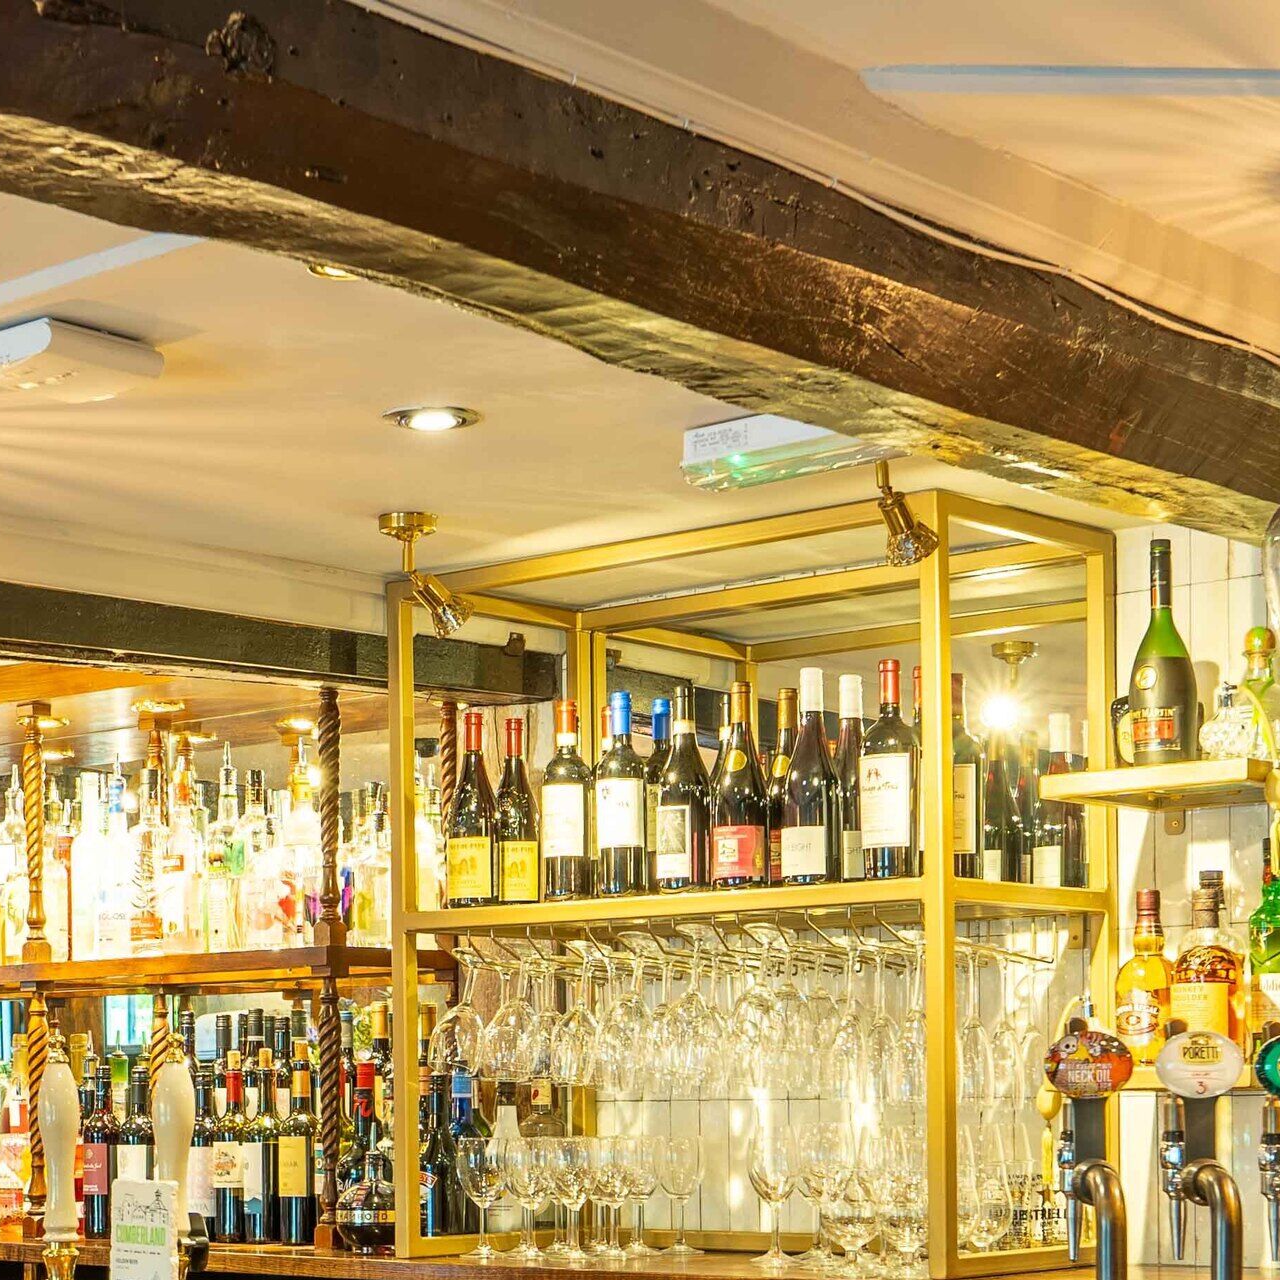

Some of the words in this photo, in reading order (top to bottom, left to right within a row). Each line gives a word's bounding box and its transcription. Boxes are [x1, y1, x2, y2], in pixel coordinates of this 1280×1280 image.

[1182, 1046, 1219, 1059] PORETTI
[1067, 1069, 1094, 1083] NECK
[1097, 1069, 1113, 1082] OIL
[1195, 1081, 1207, 1095] 3
[115, 1224, 166, 1246] CUMBERLAND
